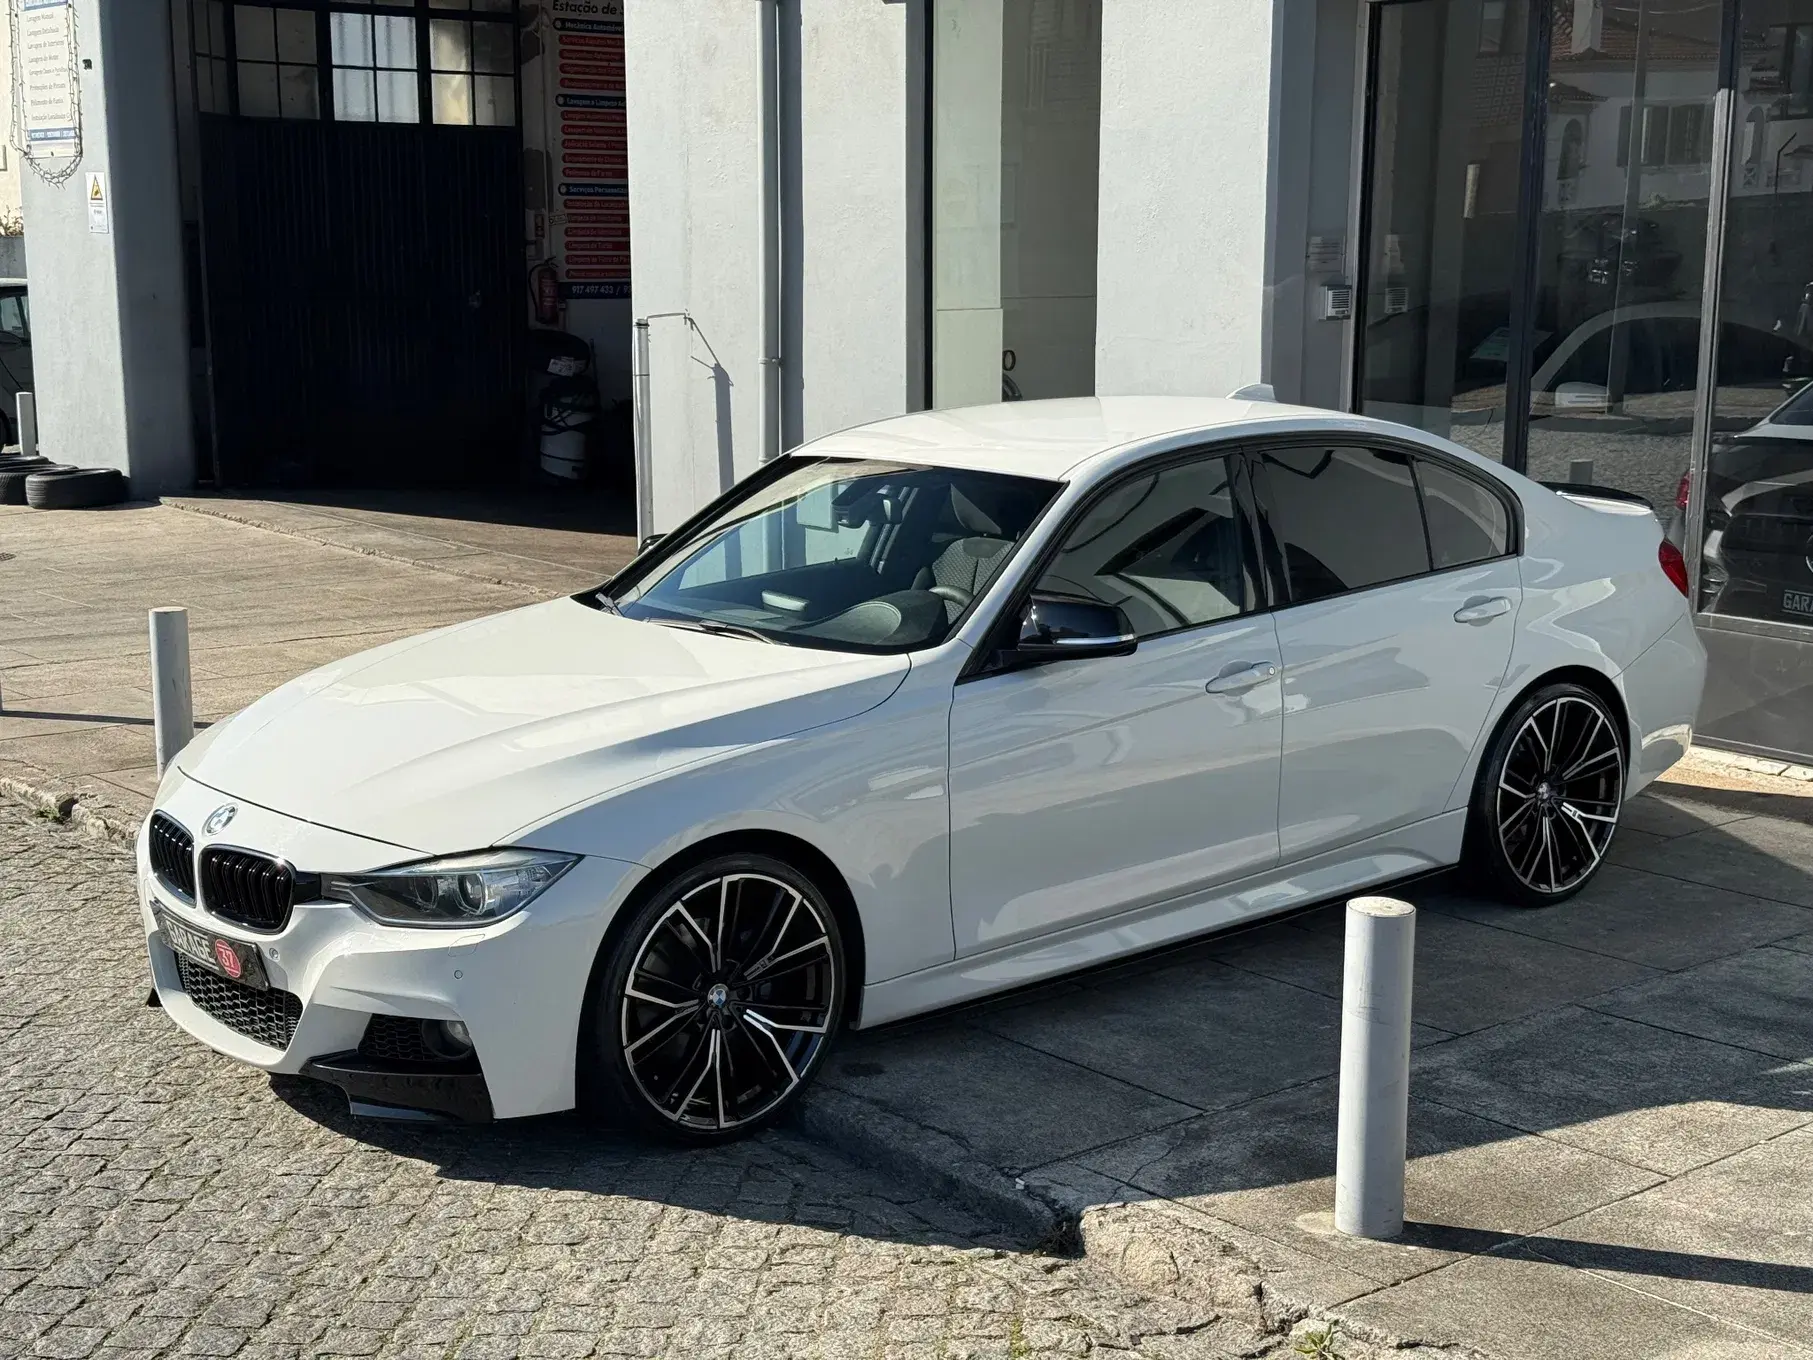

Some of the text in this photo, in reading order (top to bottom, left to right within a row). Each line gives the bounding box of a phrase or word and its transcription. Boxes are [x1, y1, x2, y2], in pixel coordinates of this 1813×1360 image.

[553, 0, 598, 16] Estação
[602, 2, 617, 15] de
[565, 21, 592, 30] Mecânica
[569, 186, 594, 194] Serviços
[572, 285, 585, 294] 917
[585, 285, 599, 295] 497
[599, 286, 614, 294] 433
[166, 919, 217, 965] GARAGE
